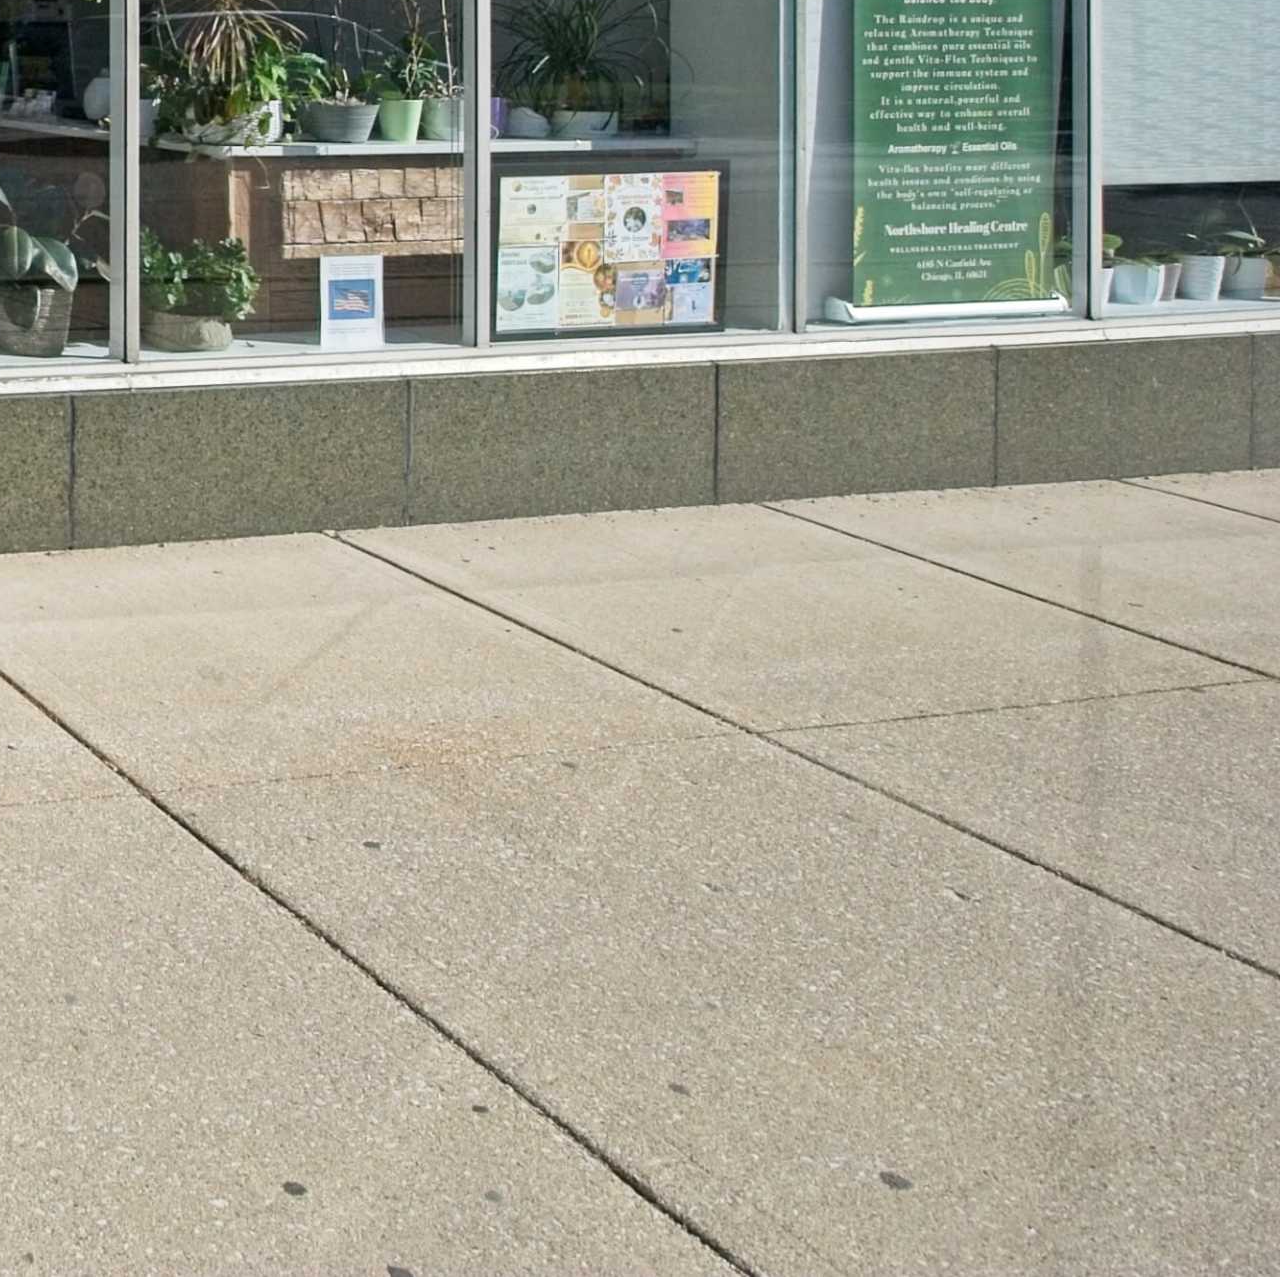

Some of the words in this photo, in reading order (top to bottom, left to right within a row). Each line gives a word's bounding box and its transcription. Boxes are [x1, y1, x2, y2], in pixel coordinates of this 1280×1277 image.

[873, 14, 895, 24] The
[899, 14, 945, 25] Raindrop
[949, 14, 958, 23] is
[970, 15, 1003, 25] unique
[1006, 14, 1023, 23] and
[864, 29, 907, 39] relaxing
[910, 28, 980, 38] Aromatherapy
[985, 27, 1034, 38] Technique
[867, 42, 888, 51] that
[892, 42, 938, 51] combines
[942, 44, 965, 52] pure
[968, 41, 1011, 50] essential
[862, 56, 880, 65] and
[883, 56, 914, 66] gentle
[970, 54, 1024, 64] Techniques
[1027, 55, 1038, 63] to
[870, 70, 910, 80] support
[913, 69, 928, 78] the
[932, 69, 971, 77] immune
[975, 69, 1008, 78] system
[1012, 68, 1029, 77] and
[880, 97, 890, 106] It
[894, 97, 904, 105] is
[1003, 94, 1021, 103] and
[870, 110, 913, 120] effective
[917, 111, 935, 119] way
[940, 110, 950, 118] to
[955, 108, 993, 118] enhance
[997, 107, 1030, 117] overall
[897, 123, 927, 132] health
[932, 122, 950, 131] and
[888, 144, 947, 154] Aromatherapy
[1000, 141, 1017, 151] Oils
[991, 161, 1031, 171] different
[867, 178, 898, 187] health
[933, 176, 950, 185] and
[877, 191, 892, 200] the
[884, 222, 947, 236] Northshore
[949, 221, 990, 235] Healing
[990, 220, 1028, 232] Centre
